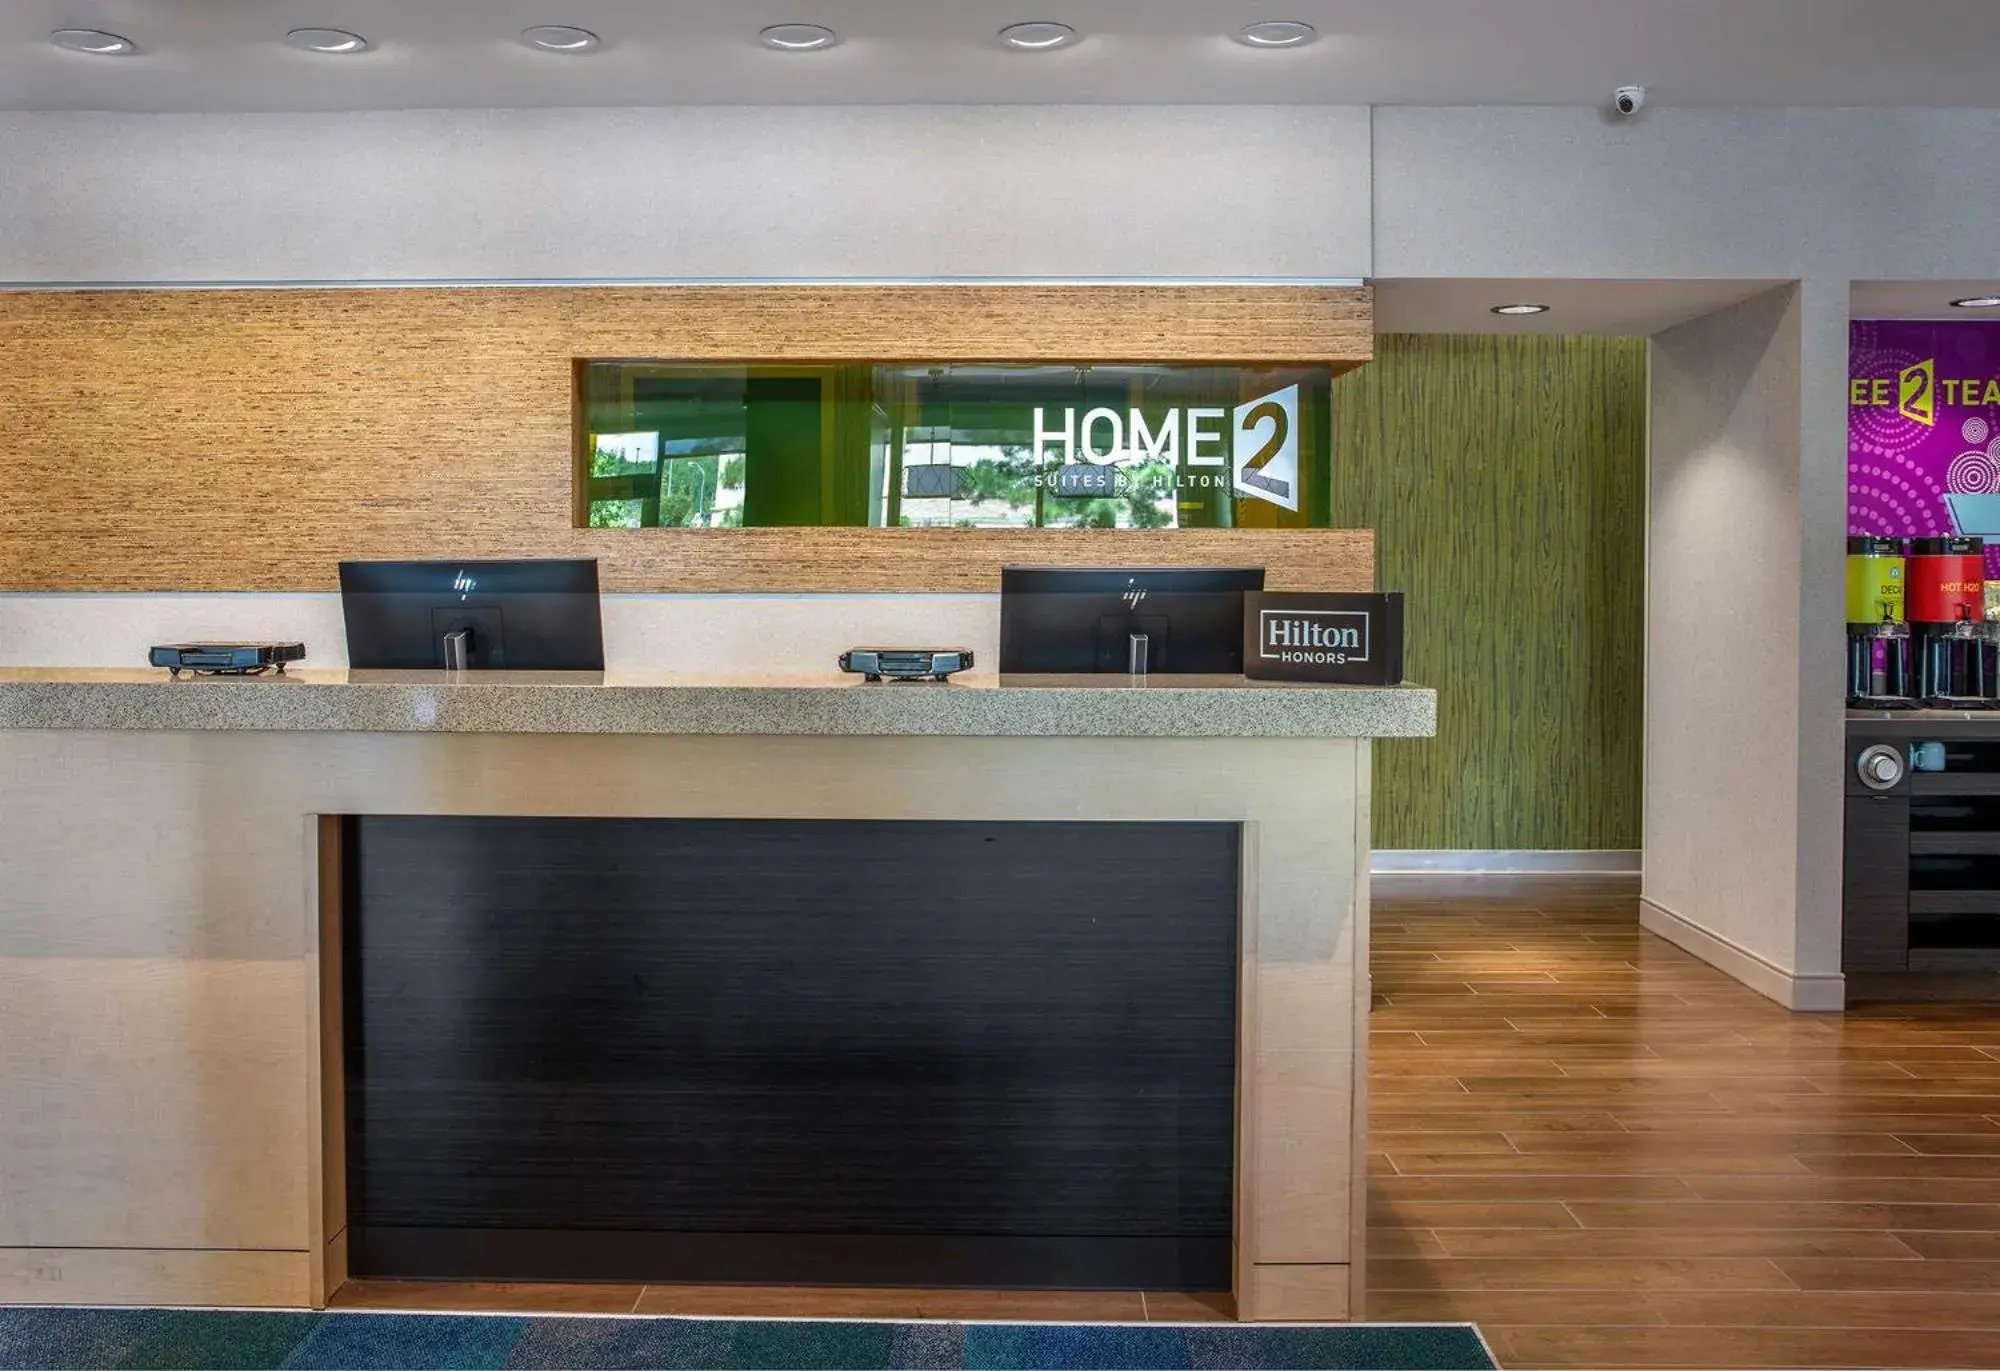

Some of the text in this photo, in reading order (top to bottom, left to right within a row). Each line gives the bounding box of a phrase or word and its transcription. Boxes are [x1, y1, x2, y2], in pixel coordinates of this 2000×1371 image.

[1902, 365, 1931, 420] 2
[1941, 379, 2000, 405] TEA
[1032, 399, 1291, 501] HOME 2
[1034, 474, 1226, 488] SUITES BY HILTON
[1940, 582, 1961, 593] HOT
[1268, 619, 1360, 648] Hilton
[1281, 651, 1347, 665] HONORS
